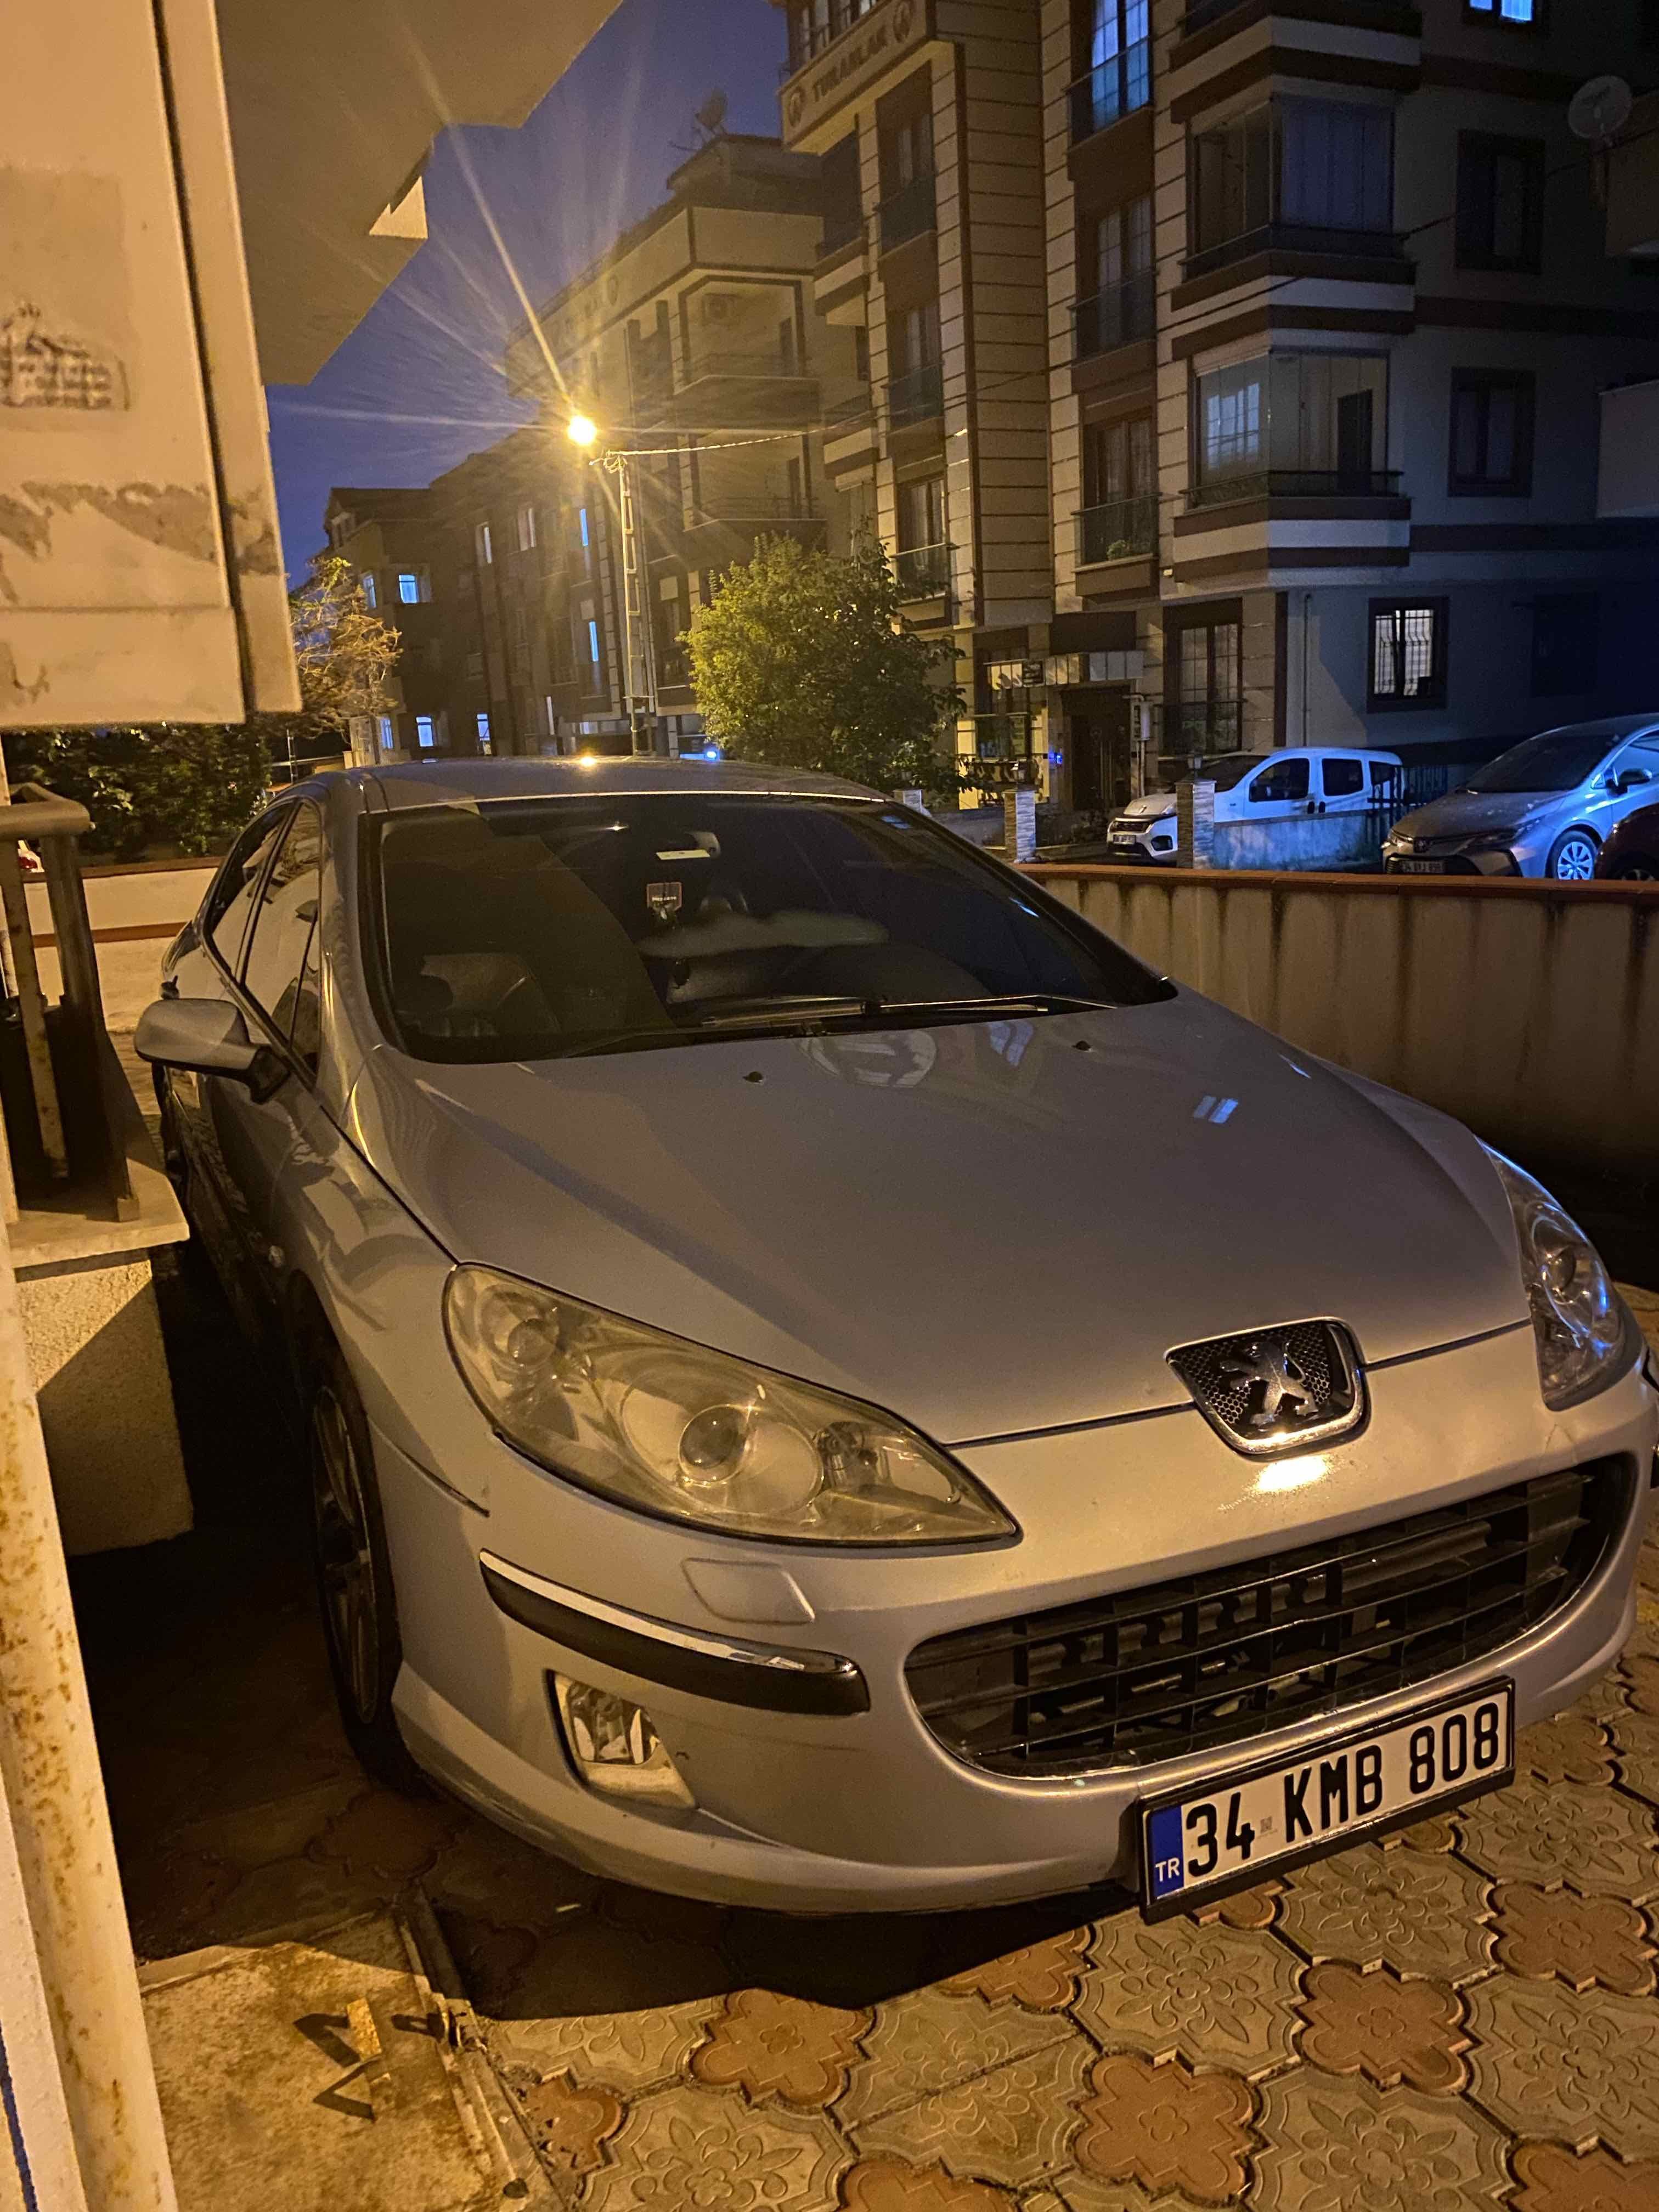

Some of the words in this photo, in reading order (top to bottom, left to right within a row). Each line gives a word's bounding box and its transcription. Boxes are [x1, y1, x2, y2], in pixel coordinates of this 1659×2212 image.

[1186, 1792, 1255, 1877] 34
[1284, 1745, 1383, 1843] KMB
[1409, 1702, 1499, 1795] 808
[1155, 1857, 1181, 1883] TR
